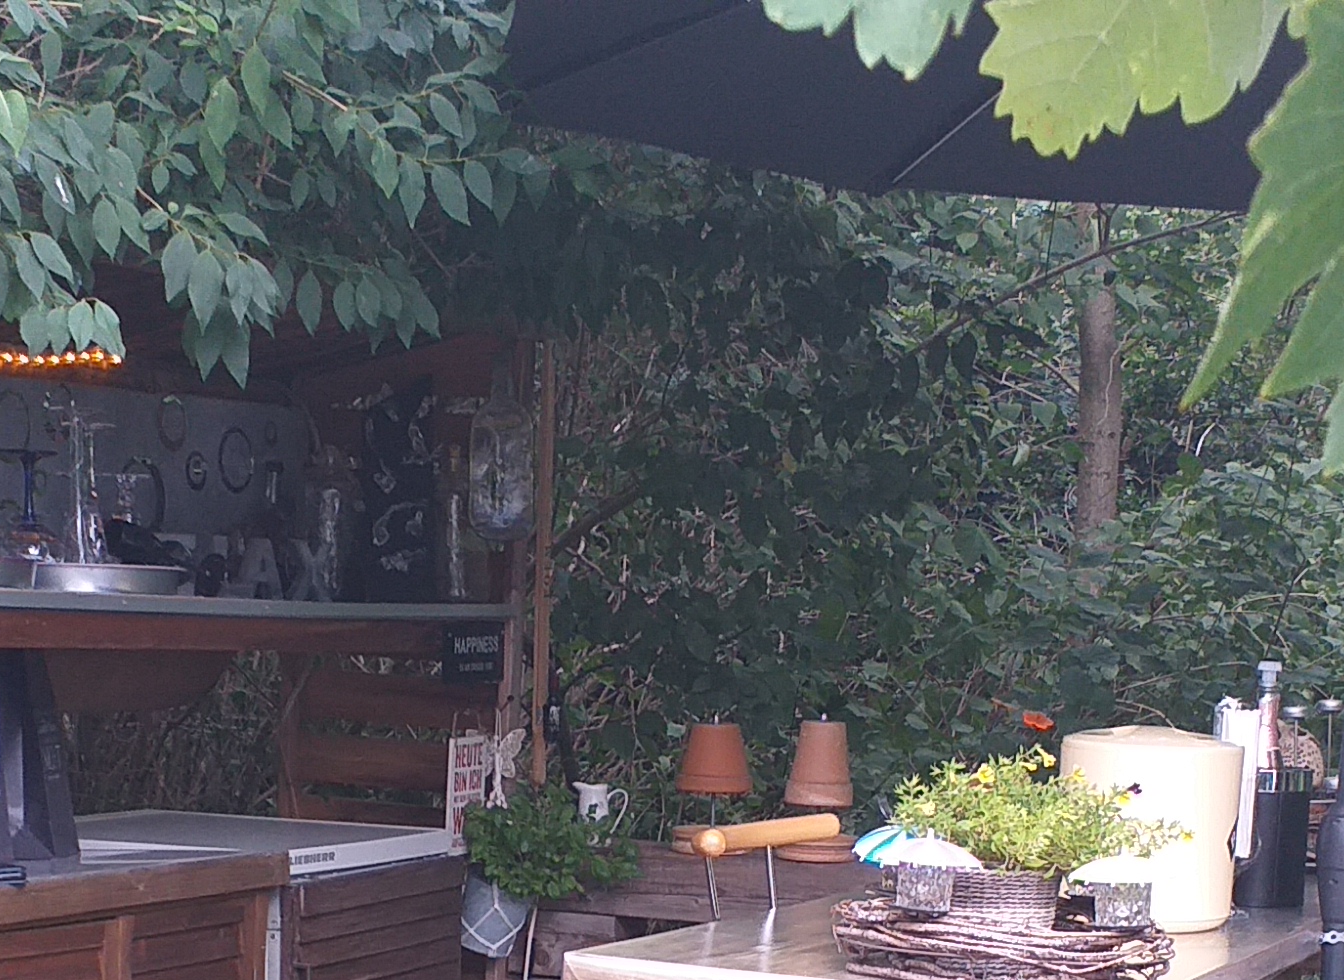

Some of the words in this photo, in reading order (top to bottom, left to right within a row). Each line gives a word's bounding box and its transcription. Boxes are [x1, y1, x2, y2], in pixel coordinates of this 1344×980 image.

[454, 635, 499, 654] HAPPINESS
[455, 743, 483, 769] HEUTE
[454, 772, 467, 793] BIN
[469, 769, 482, 791] ICH
[290, 851, 336, 866] LIEBHERR
